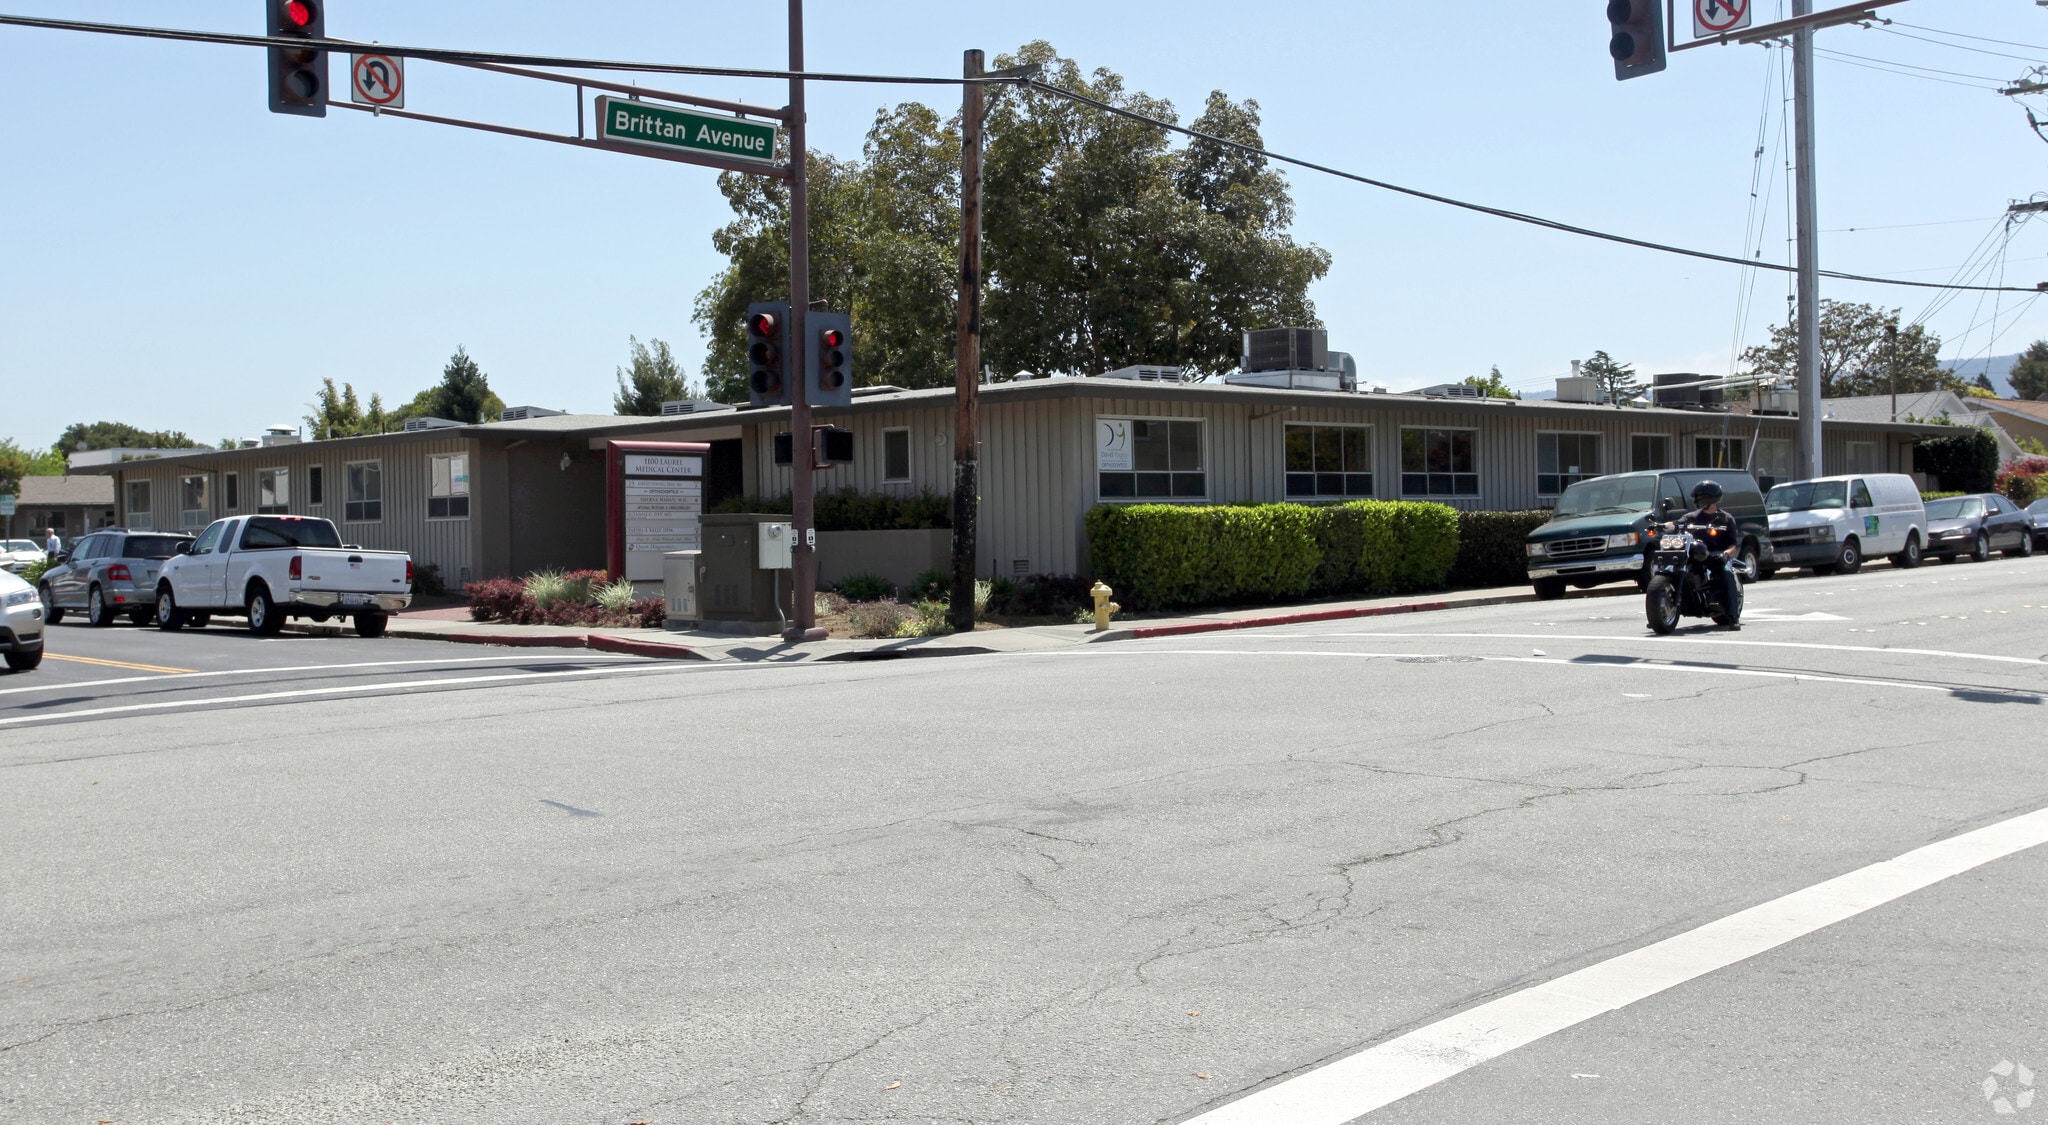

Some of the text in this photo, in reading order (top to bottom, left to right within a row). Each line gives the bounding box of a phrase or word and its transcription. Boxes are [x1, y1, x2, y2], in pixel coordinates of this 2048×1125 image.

[615, 110, 766, 151] Brittan Avenue
[660, 458, 683, 466] LAUREL
